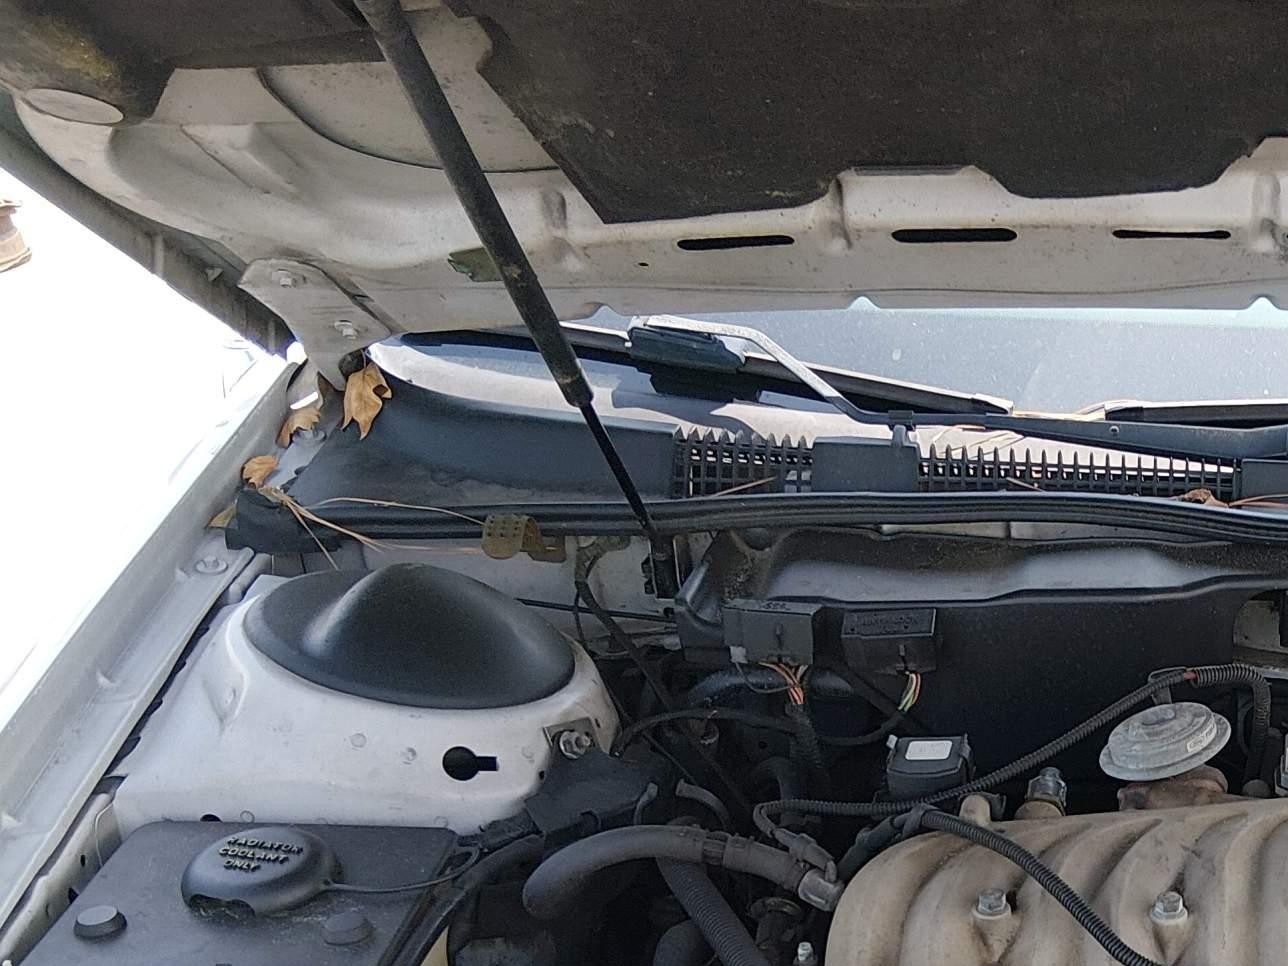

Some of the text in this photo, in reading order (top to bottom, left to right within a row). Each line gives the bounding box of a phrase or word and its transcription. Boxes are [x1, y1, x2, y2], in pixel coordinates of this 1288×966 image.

[226, 838, 303, 854] RADIATOR
[219, 847, 289, 863] COOLANT
[224, 859, 261, 872] ONLY
